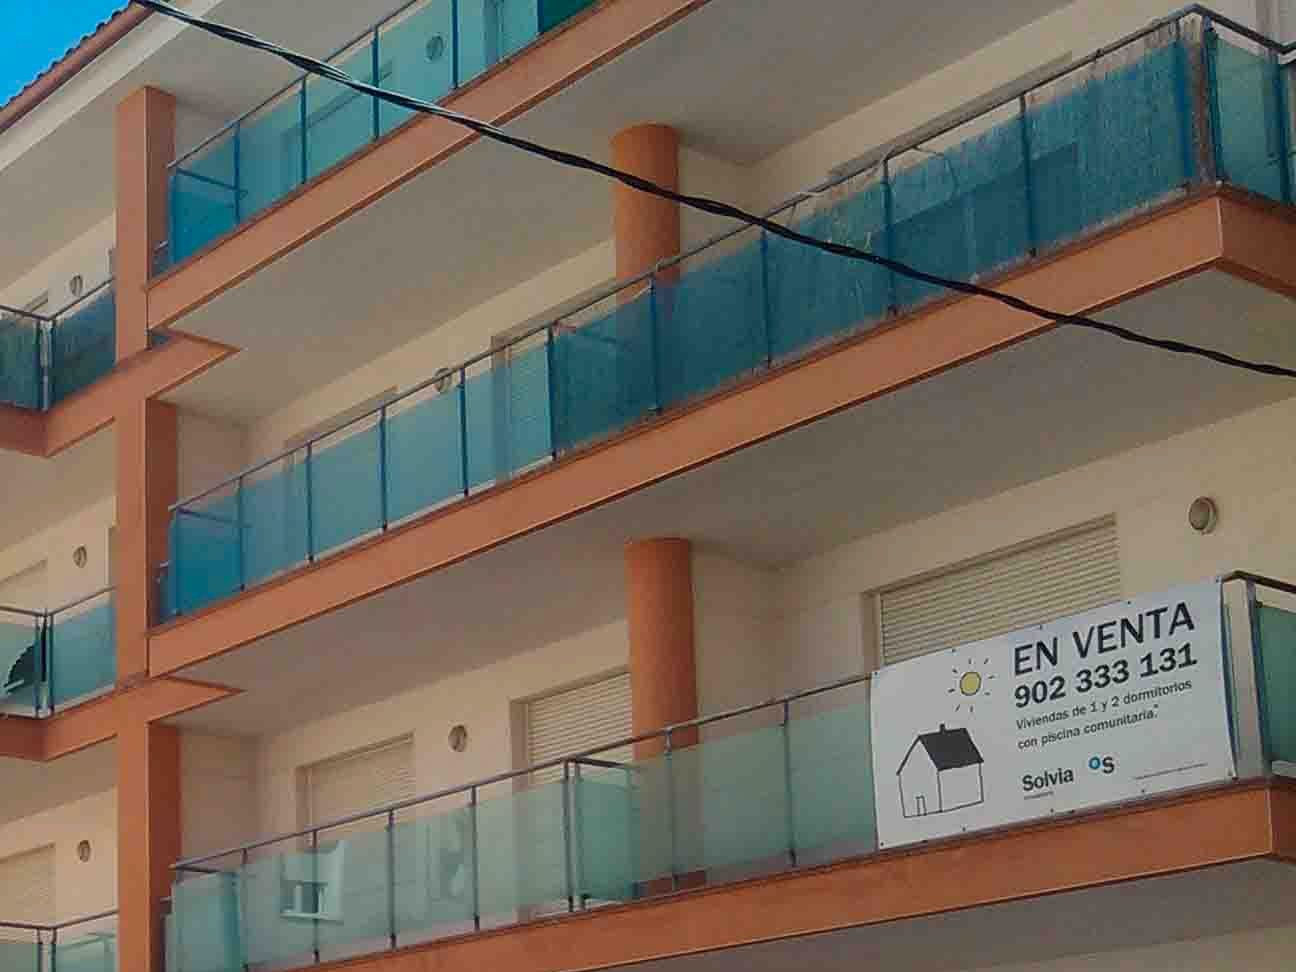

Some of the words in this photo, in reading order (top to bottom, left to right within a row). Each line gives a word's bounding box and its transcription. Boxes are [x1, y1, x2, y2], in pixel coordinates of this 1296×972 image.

[1014, 636, 1058, 676] EN
[1072, 602, 1195, 659] VENTA
[1015, 675, 1066, 708] 902
[1075, 659, 1130, 693] 333
[1140, 642, 1198, 678] 131
[1016, 708, 1069, 730] Viviendas
[1072, 705, 1086, 718] de
[1101, 701, 1108, 713] y
[1111, 696, 1120, 708] 2
[1123, 679, 1192, 705] dormitorios
[1017, 737, 1038, 750] con
[1041, 726, 1080, 747] piscina
[1022, 767, 1074, 792] Solvia
